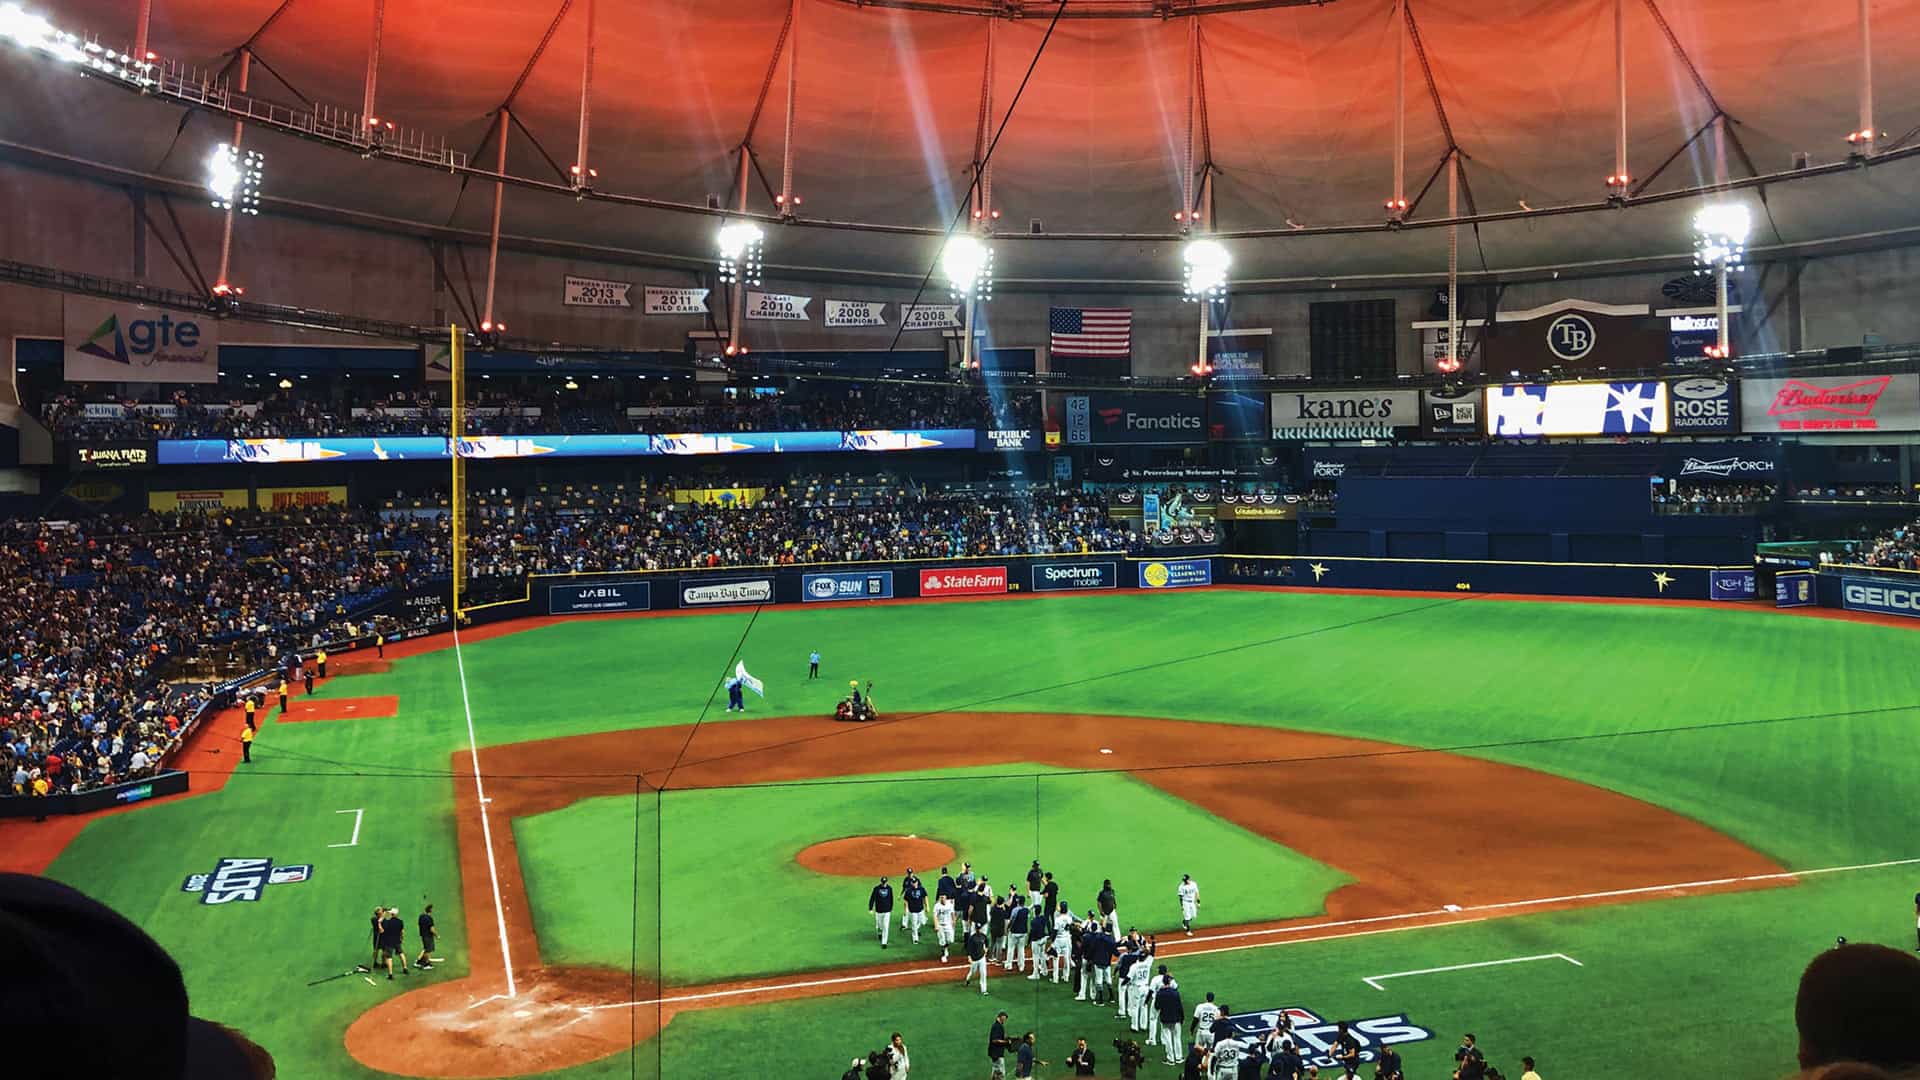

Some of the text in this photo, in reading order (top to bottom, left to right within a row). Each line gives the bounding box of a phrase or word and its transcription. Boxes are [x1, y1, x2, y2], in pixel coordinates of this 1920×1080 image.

[582, 287, 614, 298] 2013
[572, 296, 593, 304] WILD
[661, 295, 691, 305] 2011
[760, 301, 793, 312] 2010
[750, 310, 801, 319] CHAMPIONS
[838, 308, 871, 319] 2008
[914, 311, 945, 321] 2008
[904, 320, 954, 328] CHAMPIONS
[129, 314, 200, 354] gte
[1556, 323, 1588, 351] TB
[1778, 389, 1878, 406] Budweiser
[1071, 400, 1086, 410] 42
[1296, 395, 1393, 419] kane's
[1674, 400, 1729, 416] ROSE
[1072, 415, 1085, 426] 12
[1126, 413, 1201, 429] Fanatics
[1674, 418, 1729, 426] RADIOLOGY
[988, 430, 1031, 439] REPUBLIC
[1071, 431, 1086, 441] 66
[996, 438, 1023, 448] BANK
[1731, 461, 1774, 471] PORCH
[1314, 468, 1345, 477] PORCH
[273, 492, 292, 508] HOT
[1045, 568, 1100, 581] Spectrum
[815, 580, 862, 592] FOX SUN
[579, 588, 622, 598] JABIL
[688, 586, 768, 600] Tampa Bay Times
[205, 858, 268, 904] ALDS
